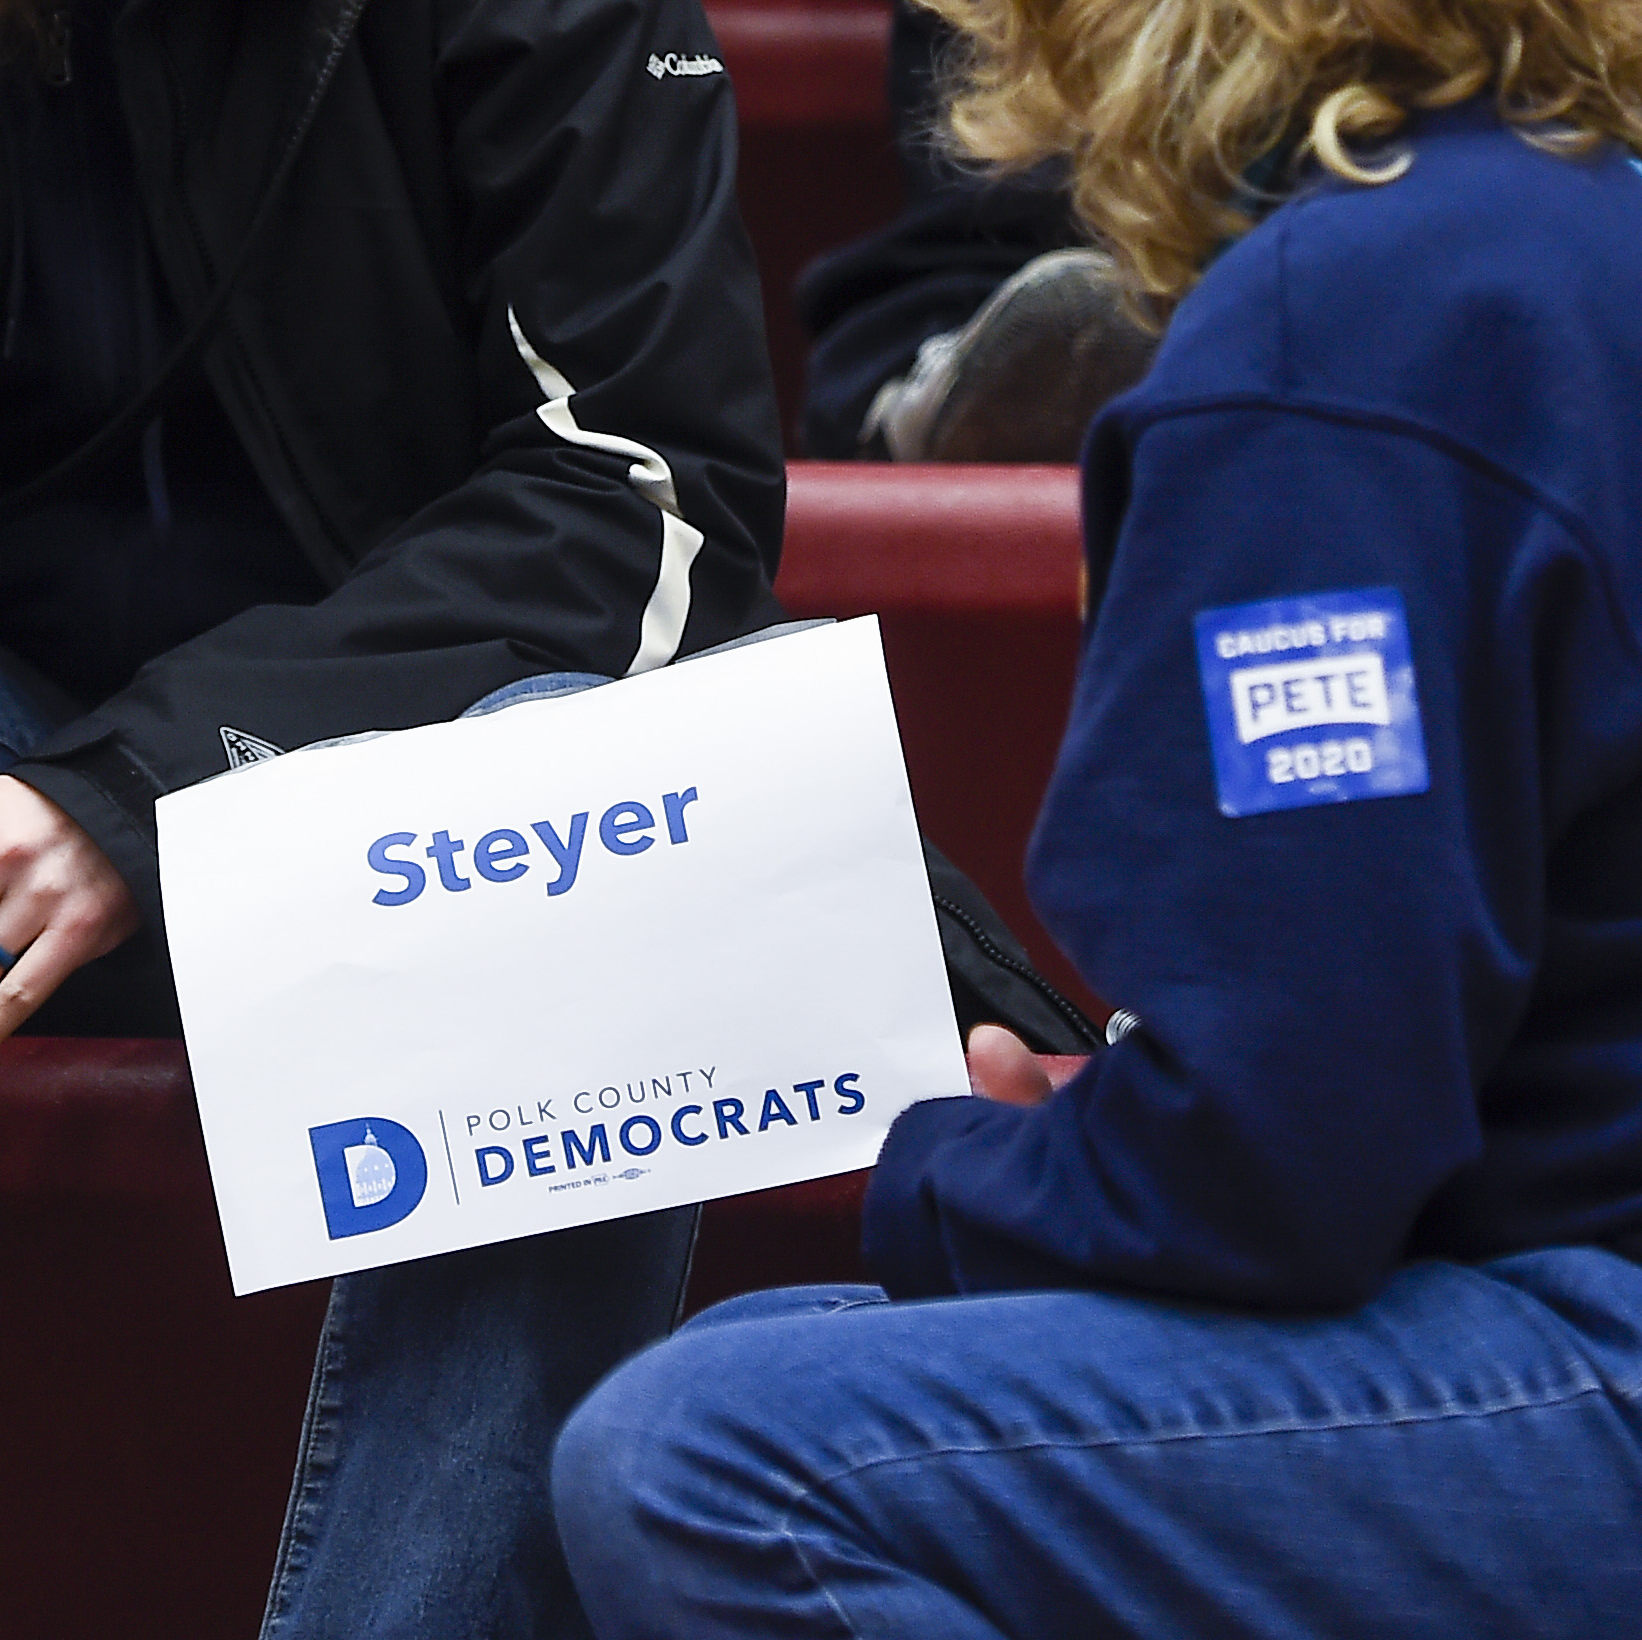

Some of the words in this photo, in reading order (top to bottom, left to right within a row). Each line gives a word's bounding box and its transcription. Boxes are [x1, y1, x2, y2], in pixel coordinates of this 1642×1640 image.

[1216, 620, 1326, 659] CAUCUS
[1328, 611, 1386, 642] FOR
[1247, 670, 1372, 724] PETE
[1266, 737, 1373, 784] 2020
[367, 786, 699, 907] Steyer
[467, 1101, 558, 1136] POLK
[573, 1066, 718, 1115] COUNTY
[474, 1072, 867, 1188] DEMOCRATS
